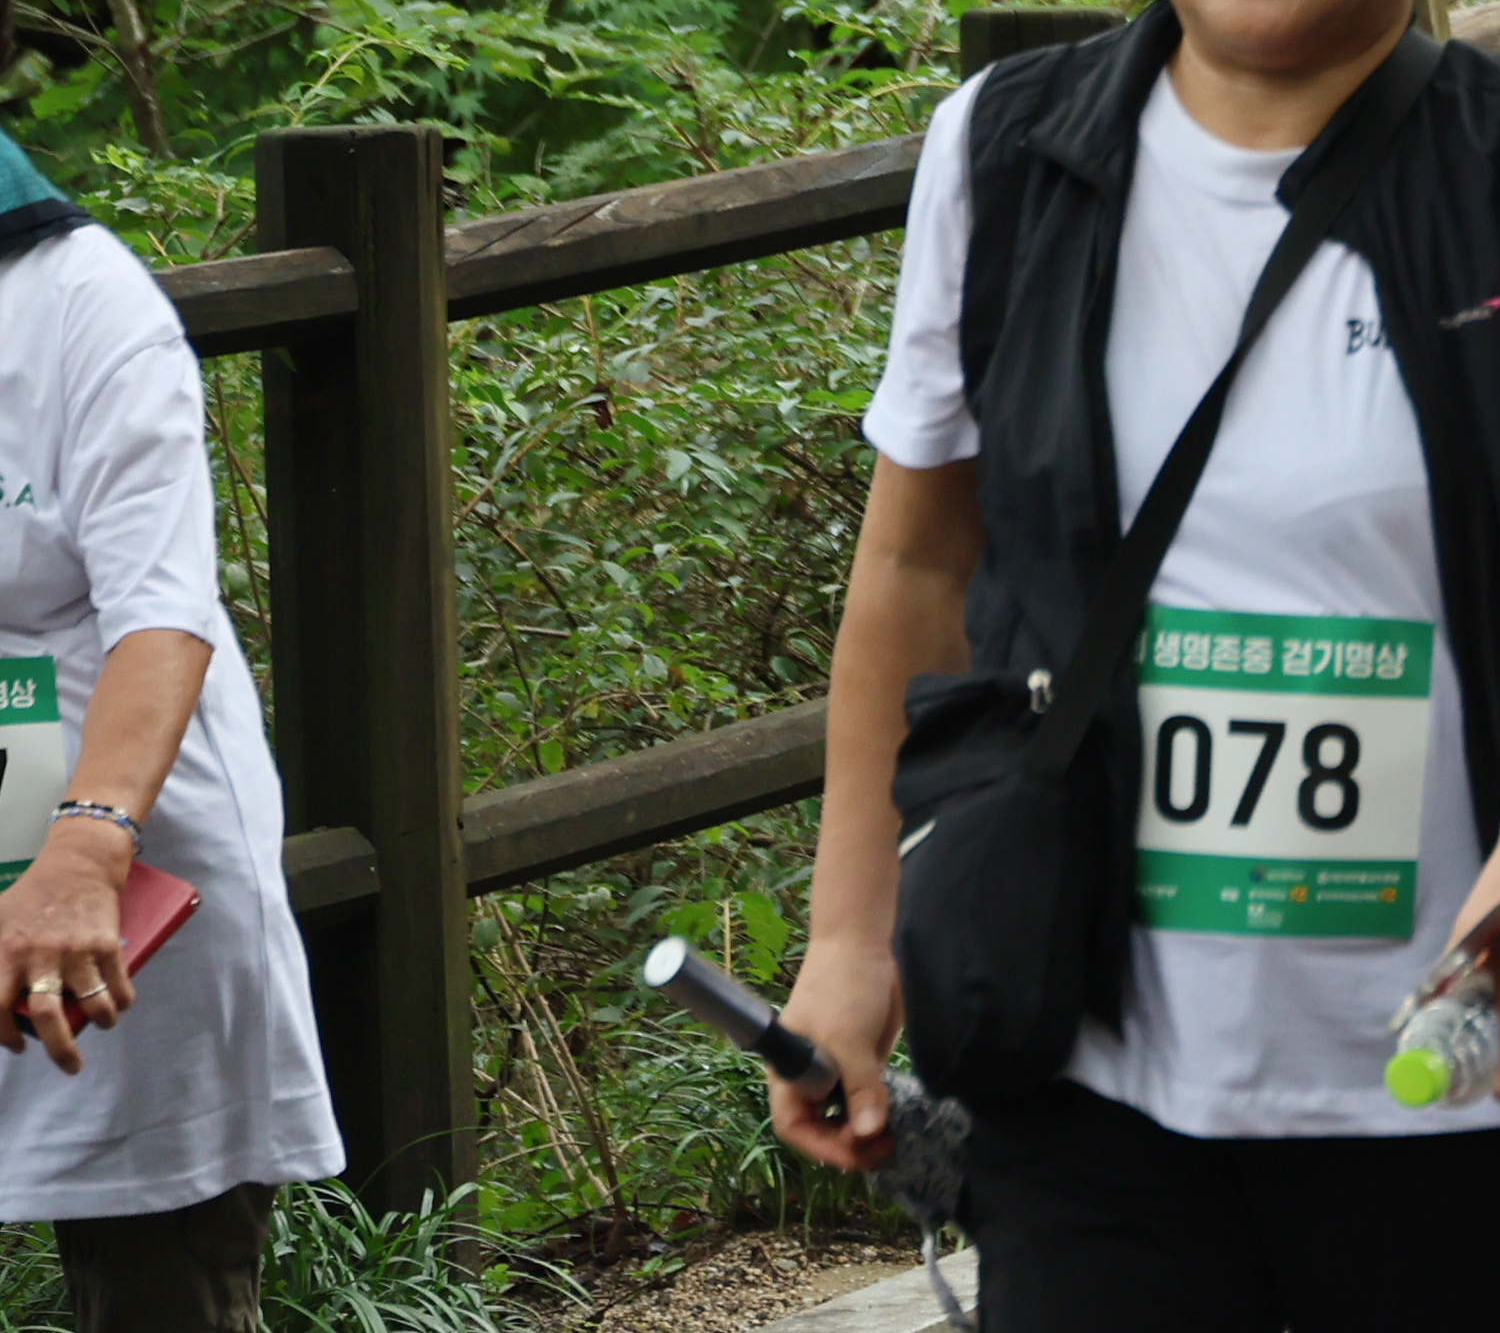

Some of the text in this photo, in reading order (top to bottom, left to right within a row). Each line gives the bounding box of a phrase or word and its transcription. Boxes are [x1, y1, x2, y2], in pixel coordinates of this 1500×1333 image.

[1154, 630, 1274, 674] 생명존중
[1281, 639, 1408, 679] 걷기명상
[1154, 714, 1361, 832] 078
